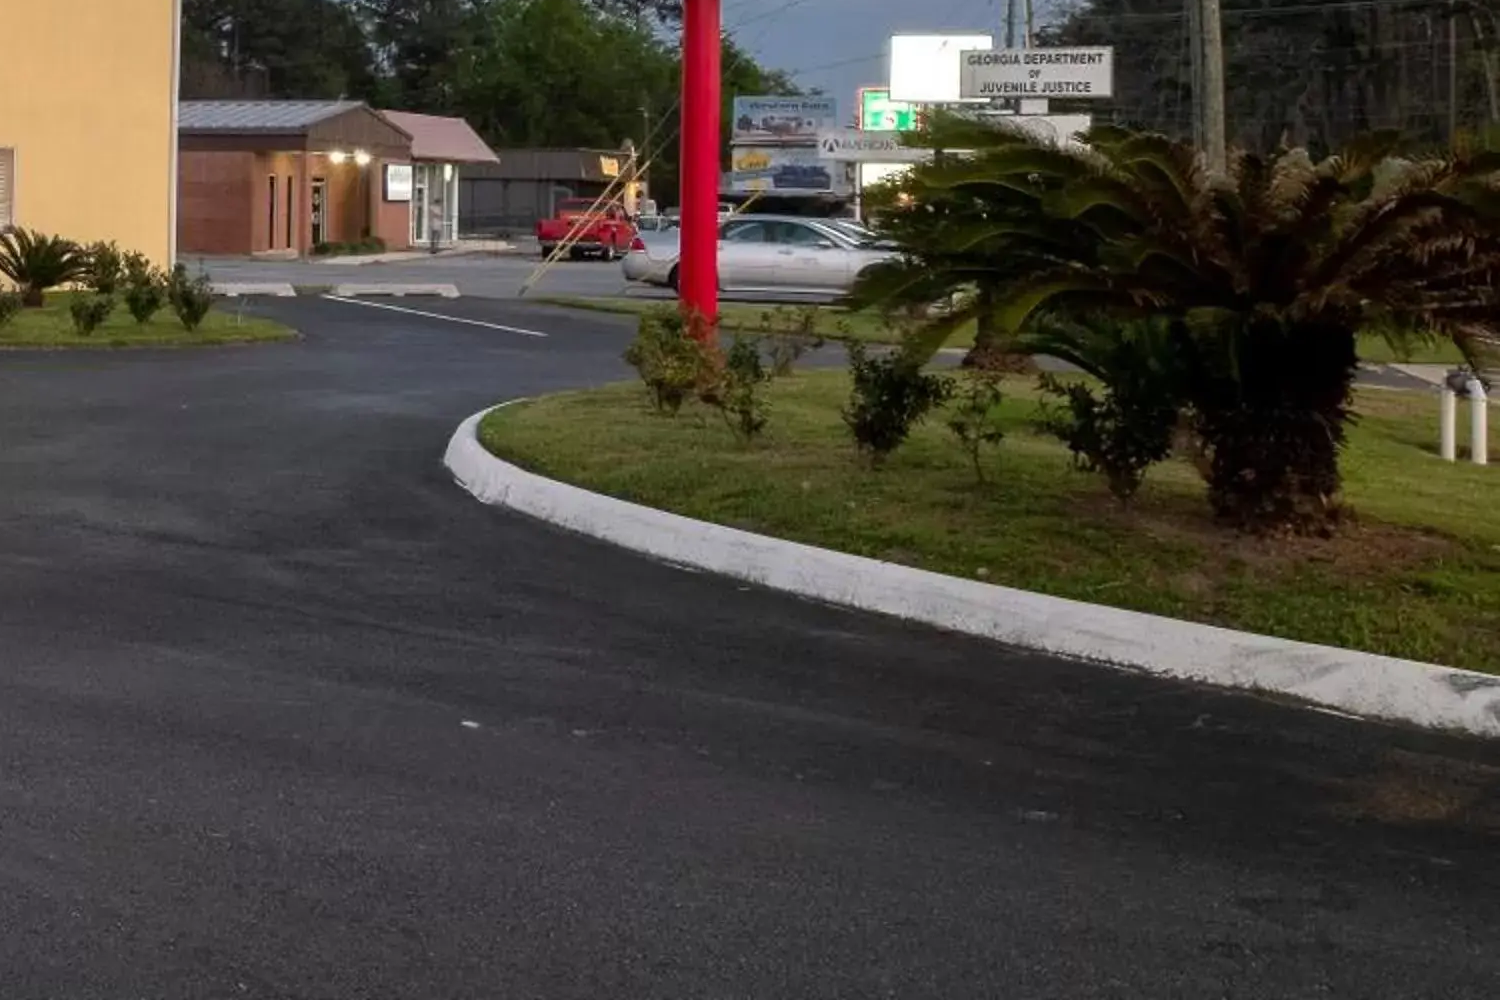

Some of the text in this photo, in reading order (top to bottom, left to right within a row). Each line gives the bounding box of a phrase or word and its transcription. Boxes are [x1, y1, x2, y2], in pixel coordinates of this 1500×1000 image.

[967, 53, 1104, 66] GEORGIA DEPARTMENT
[1028, 69, 1042, 79] OF
[980, 81, 1092, 93] JUVENILE JUSTICE
